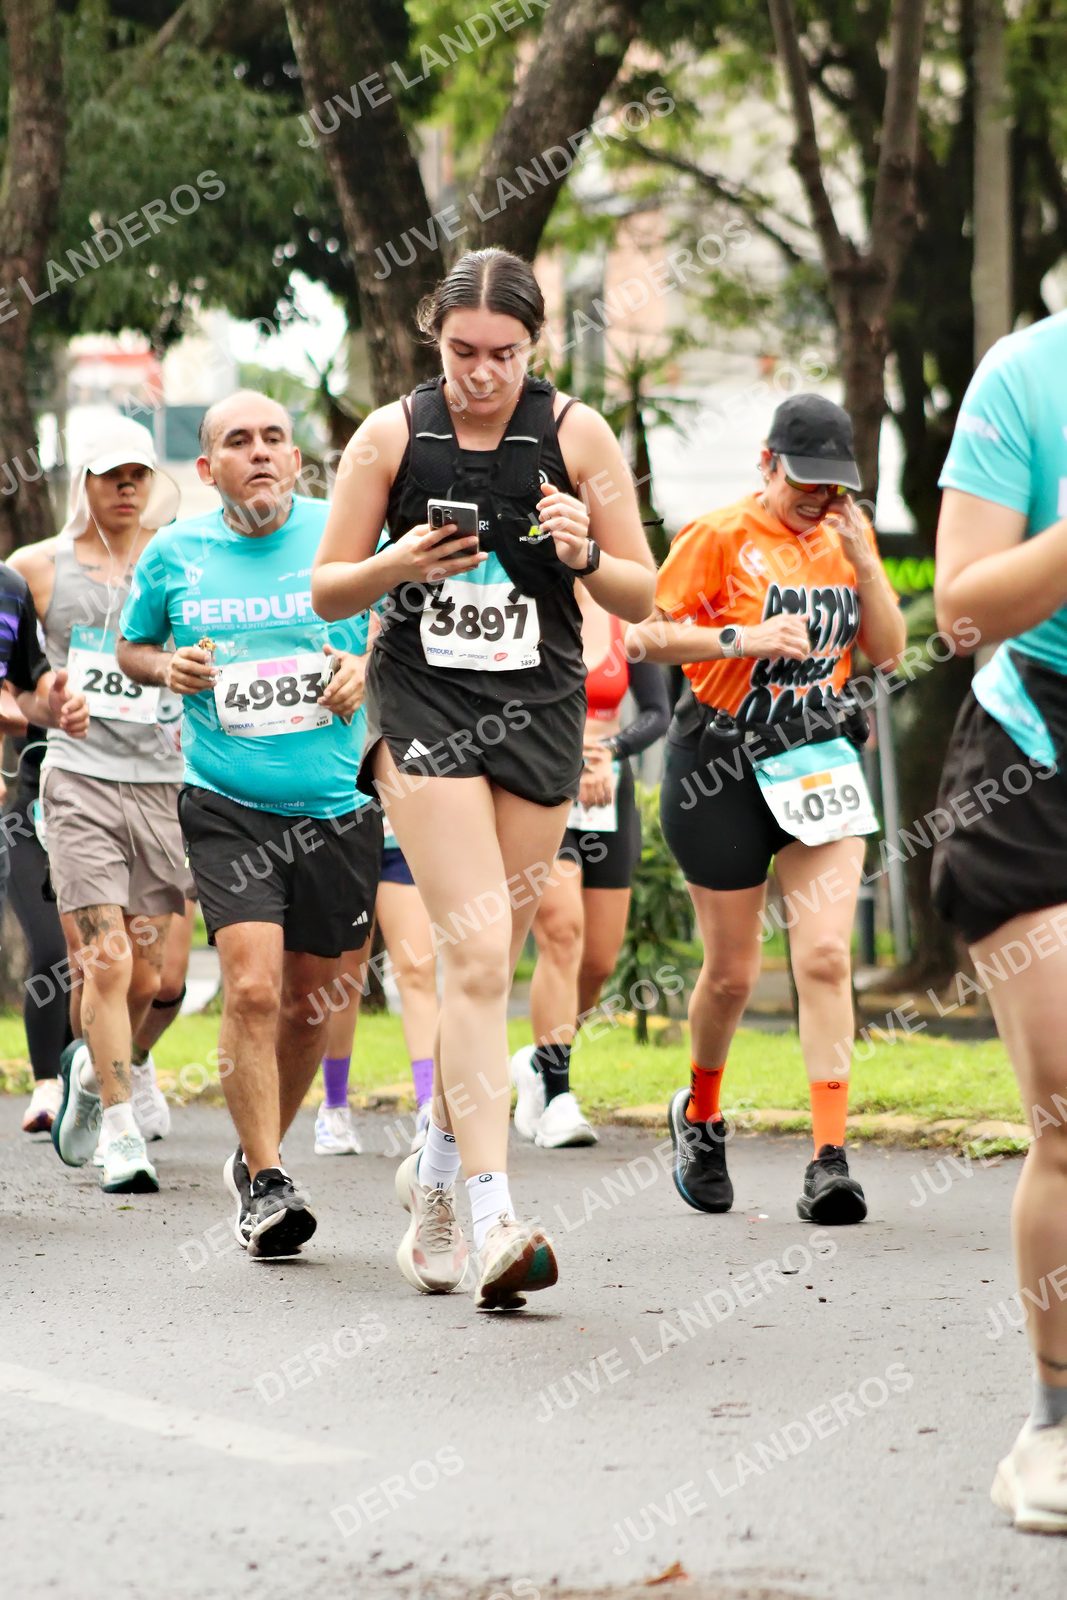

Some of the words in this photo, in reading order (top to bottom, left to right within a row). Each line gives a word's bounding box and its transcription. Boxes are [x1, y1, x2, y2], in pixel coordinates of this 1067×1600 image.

[182, 591, 314, 625] PERDUR
[428, 601, 529, 642] 3897
[224, 672, 324, 713] 4983
[783, 784, 861, 825] 4039
